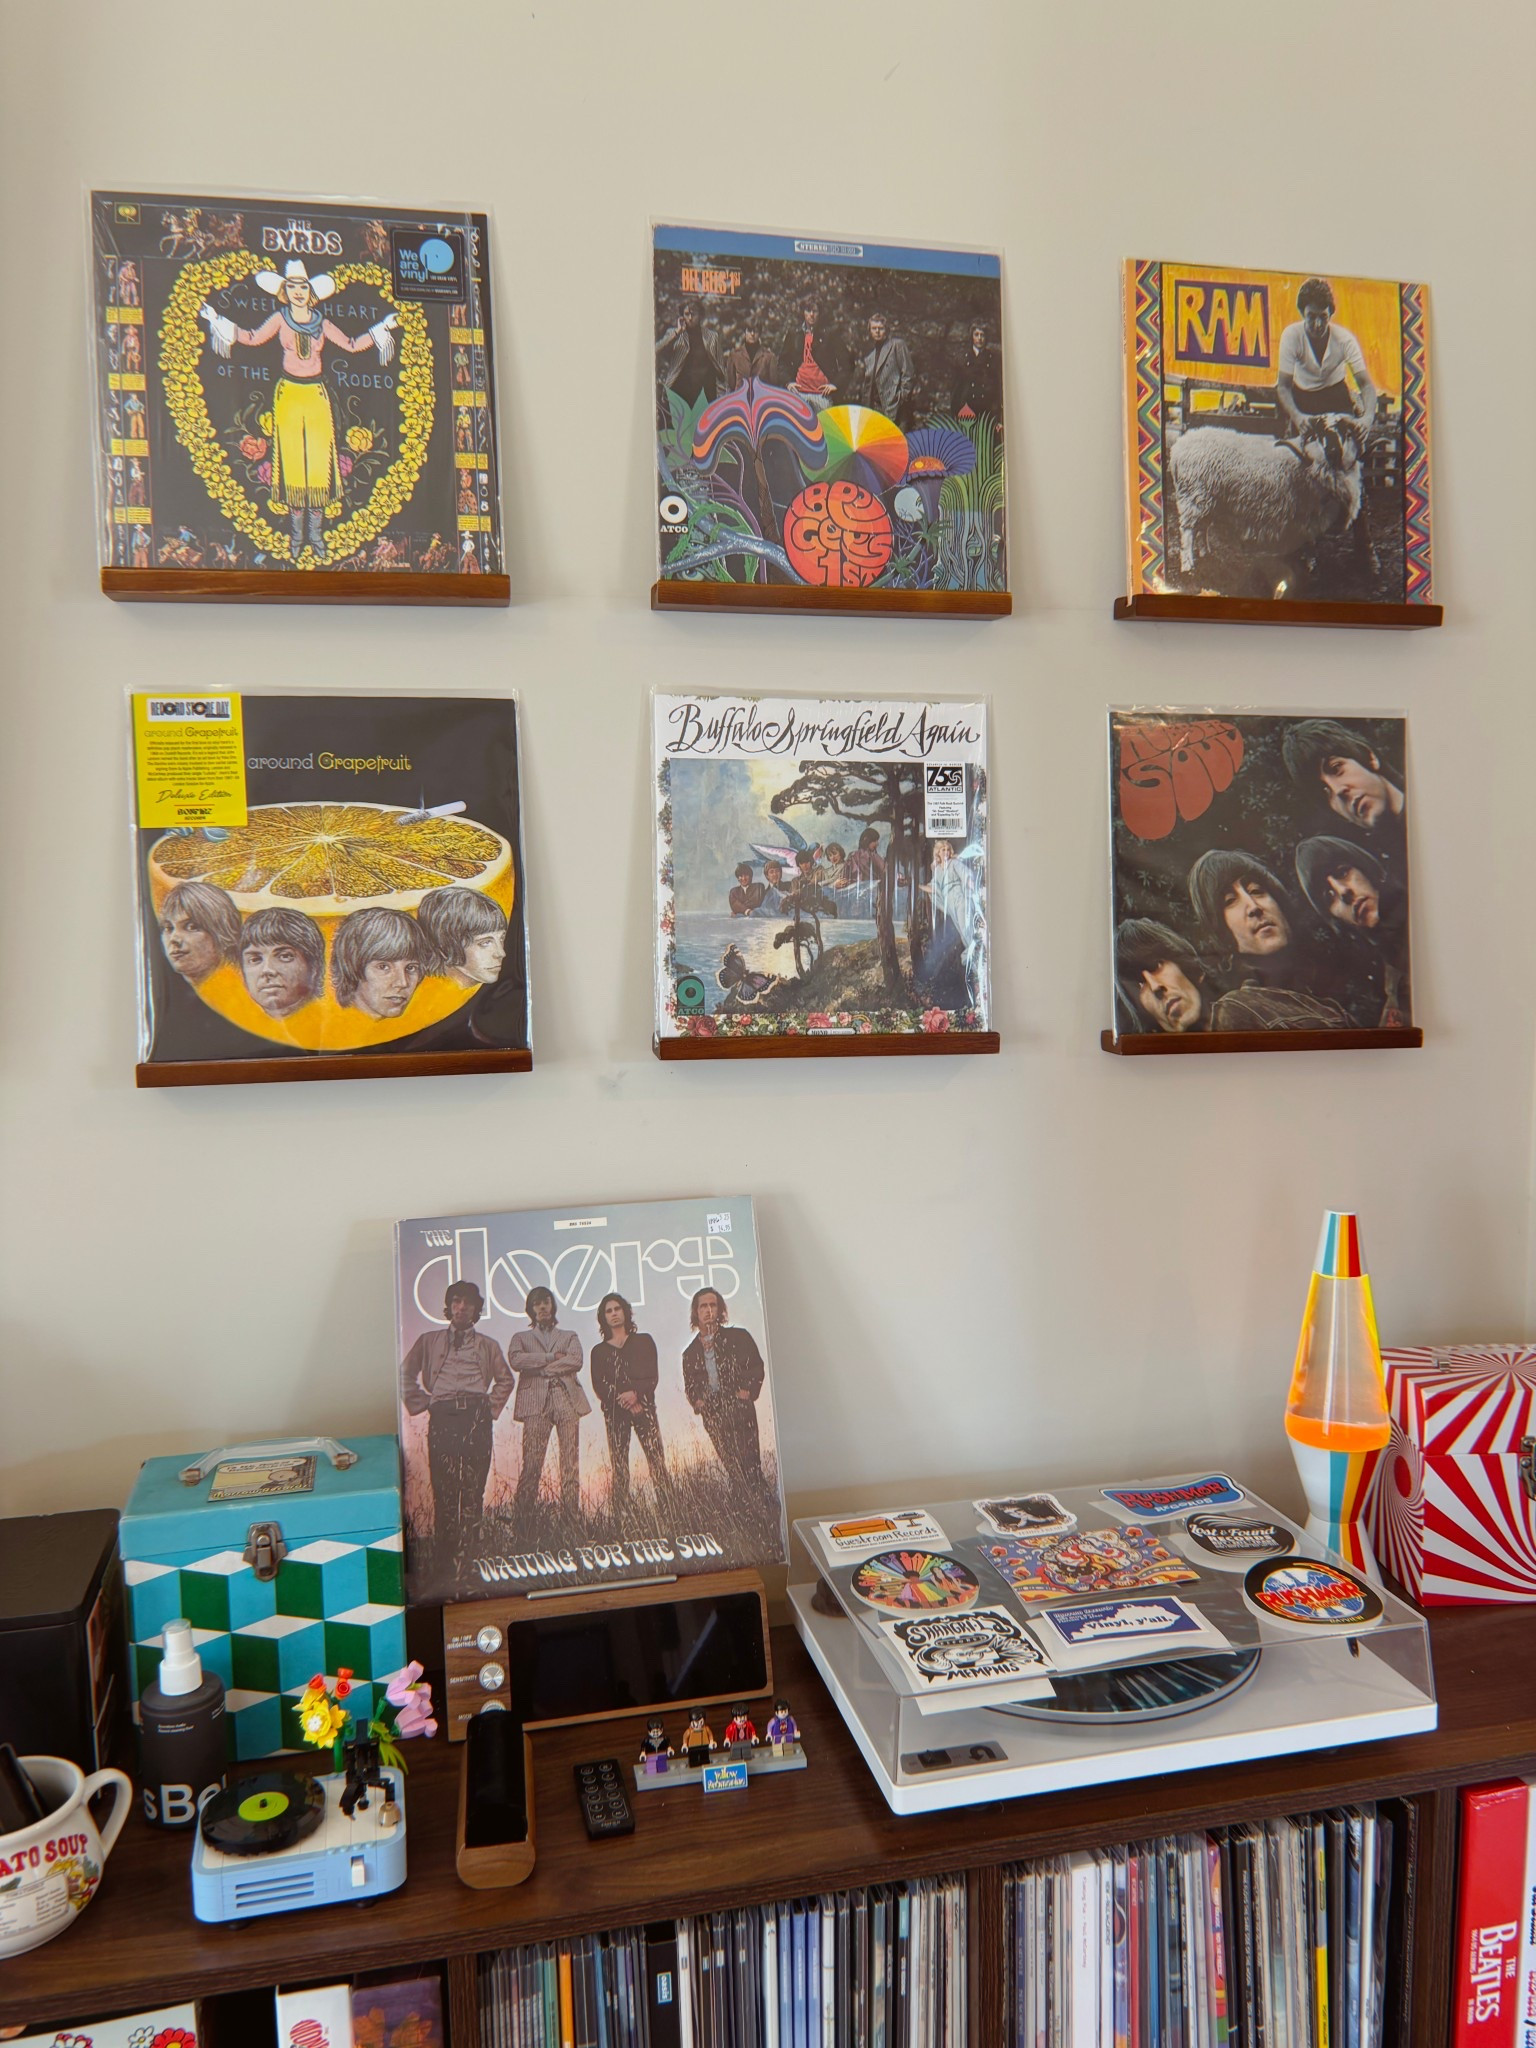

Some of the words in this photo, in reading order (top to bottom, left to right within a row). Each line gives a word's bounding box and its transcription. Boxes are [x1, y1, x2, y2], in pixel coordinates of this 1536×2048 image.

[287, 218, 313, 231] THE
[262, 226, 343, 256] BYRDS
[399, 248, 418, 261] We
[400, 260, 419, 270] are
[400, 253, 429, 283] vinyl
[681, 267, 700, 293] BEE
[323, 303, 379, 321] HEART
[1177, 284, 1269, 358] RAM
[217, 365, 236, 378] OF
[241, 367, 271, 382] THE
[659, 525, 688, 534] ATCO
[151, 702, 185, 716] RECORD
[186, 702, 214, 716] STORE
[216, 701, 230, 715] DAY
[185, 726, 239, 740] Grapefruit
[666, 703, 764, 752] Buffalo
[762, 706, 908, 757] Springfield
[899, 706, 980, 758] Again
[247, 753, 314, 770] around
[318, 751, 413, 776] Grapefruit
[678, 1007, 705, 1015] ATCO
[420, 1230, 454, 1247] THE
[1112, 1481, 1228, 1509] RUSHMOR
[1154, 1497, 1213, 1512] RECORDS
[835, 1533, 893, 1547] Guestroom
[892, 1526, 938, 1539] Records
[1189, 1523, 1218, 1537] Lost
[1228, 1526, 1277, 1537] Found
[473, 1549, 577, 1583] WAITING
[576, 1541, 630, 1571] FOR
[624, 1538, 675, 1564] THE
[676, 1532, 724, 1559] SUN
[1255, 1581, 1361, 1609] RUSHMOR
[1087, 1617, 1134, 1630] Vinyl,
[1136, 1615, 1173, 1626] y'all.
[947, 1662, 1020, 1681] MEMPHIS
[714, 1767, 738, 1781] Yellow
[44, 1833, 88, 1863] SOUP
[1471, 1920, 1518, 2023] BEATLES
[1505, 1955, 1517, 1979] THE
[660, 1975, 670, 2000] oasis
